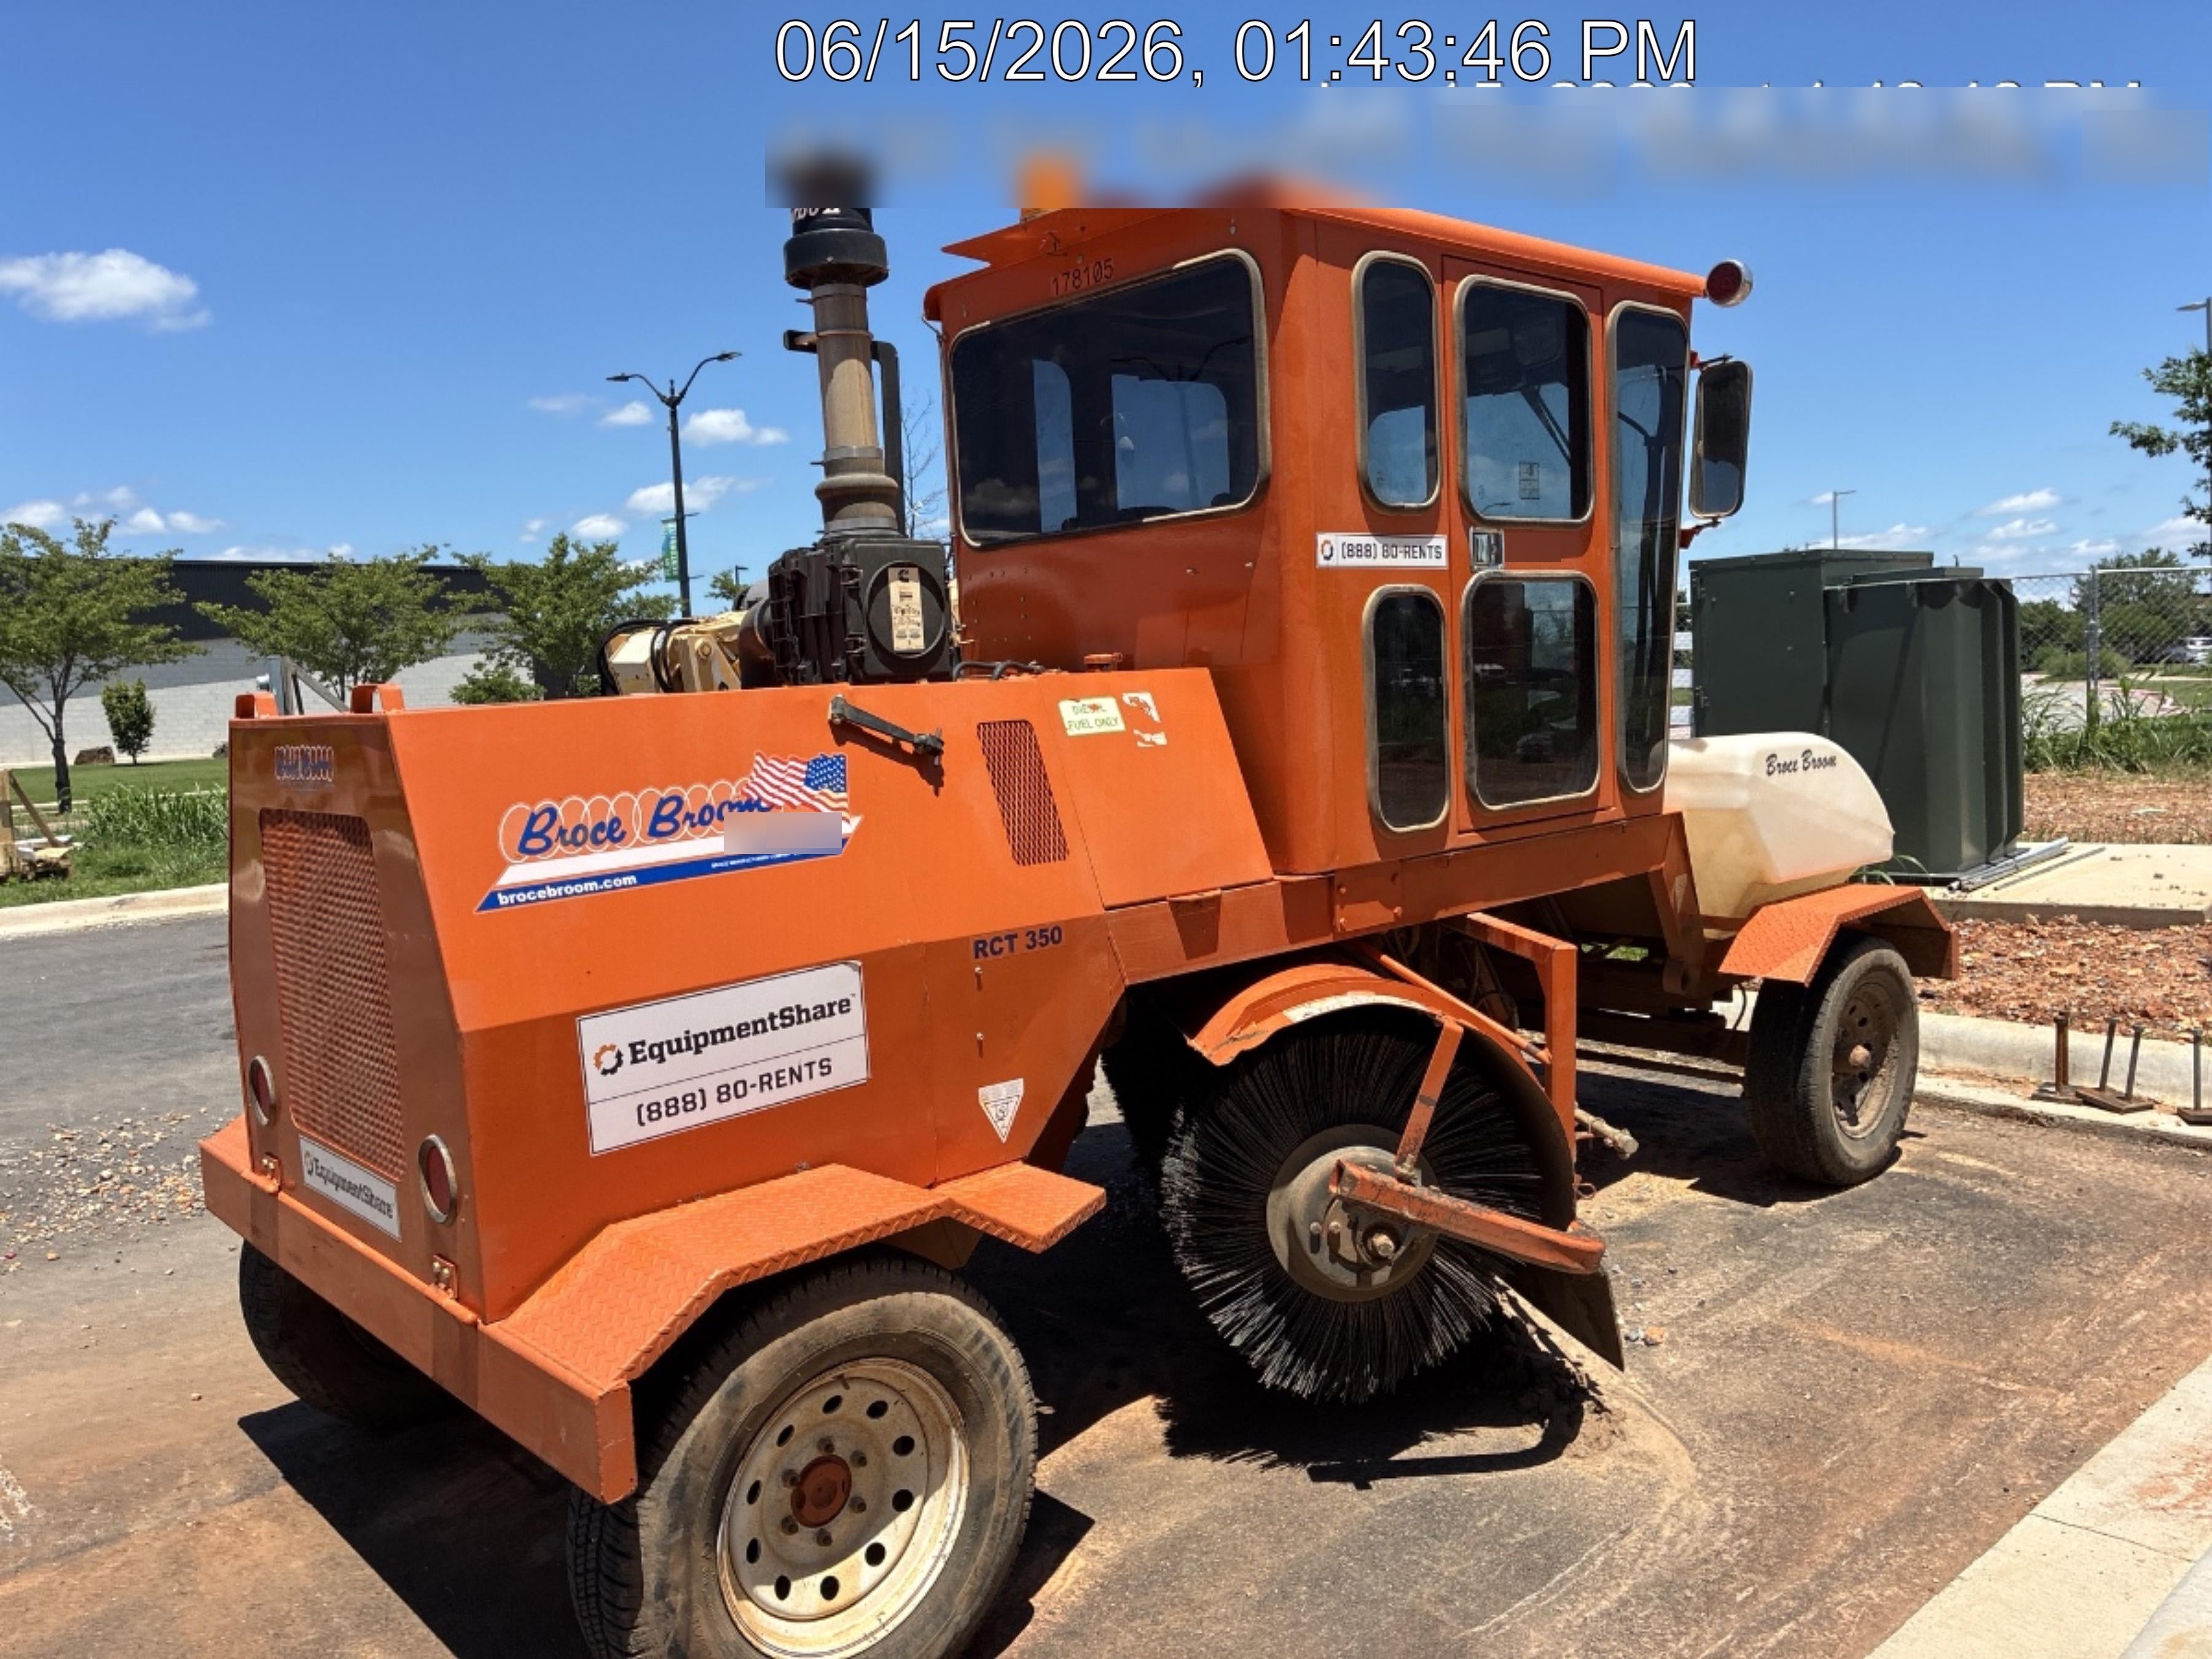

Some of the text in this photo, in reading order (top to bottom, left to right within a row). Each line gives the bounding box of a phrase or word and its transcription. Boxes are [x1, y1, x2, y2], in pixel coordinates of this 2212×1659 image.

[1052, 257, 1114, 296] 178105
[1341, 541, 1442, 560] (888) 80-RENTS
[1067, 718, 1093, 731] FUEL
[1765, 748, 1837, 777] Broce Broom
[518, 806, 627, 855] Broce
[498, 874, 637, 906] brocebroom.com
[973, 925, 1062, 959] RCT 350
[627, 997, 852, 1065] EquipmentShare
[637, 1057, 833, 1126] (888) 80-RENTS
